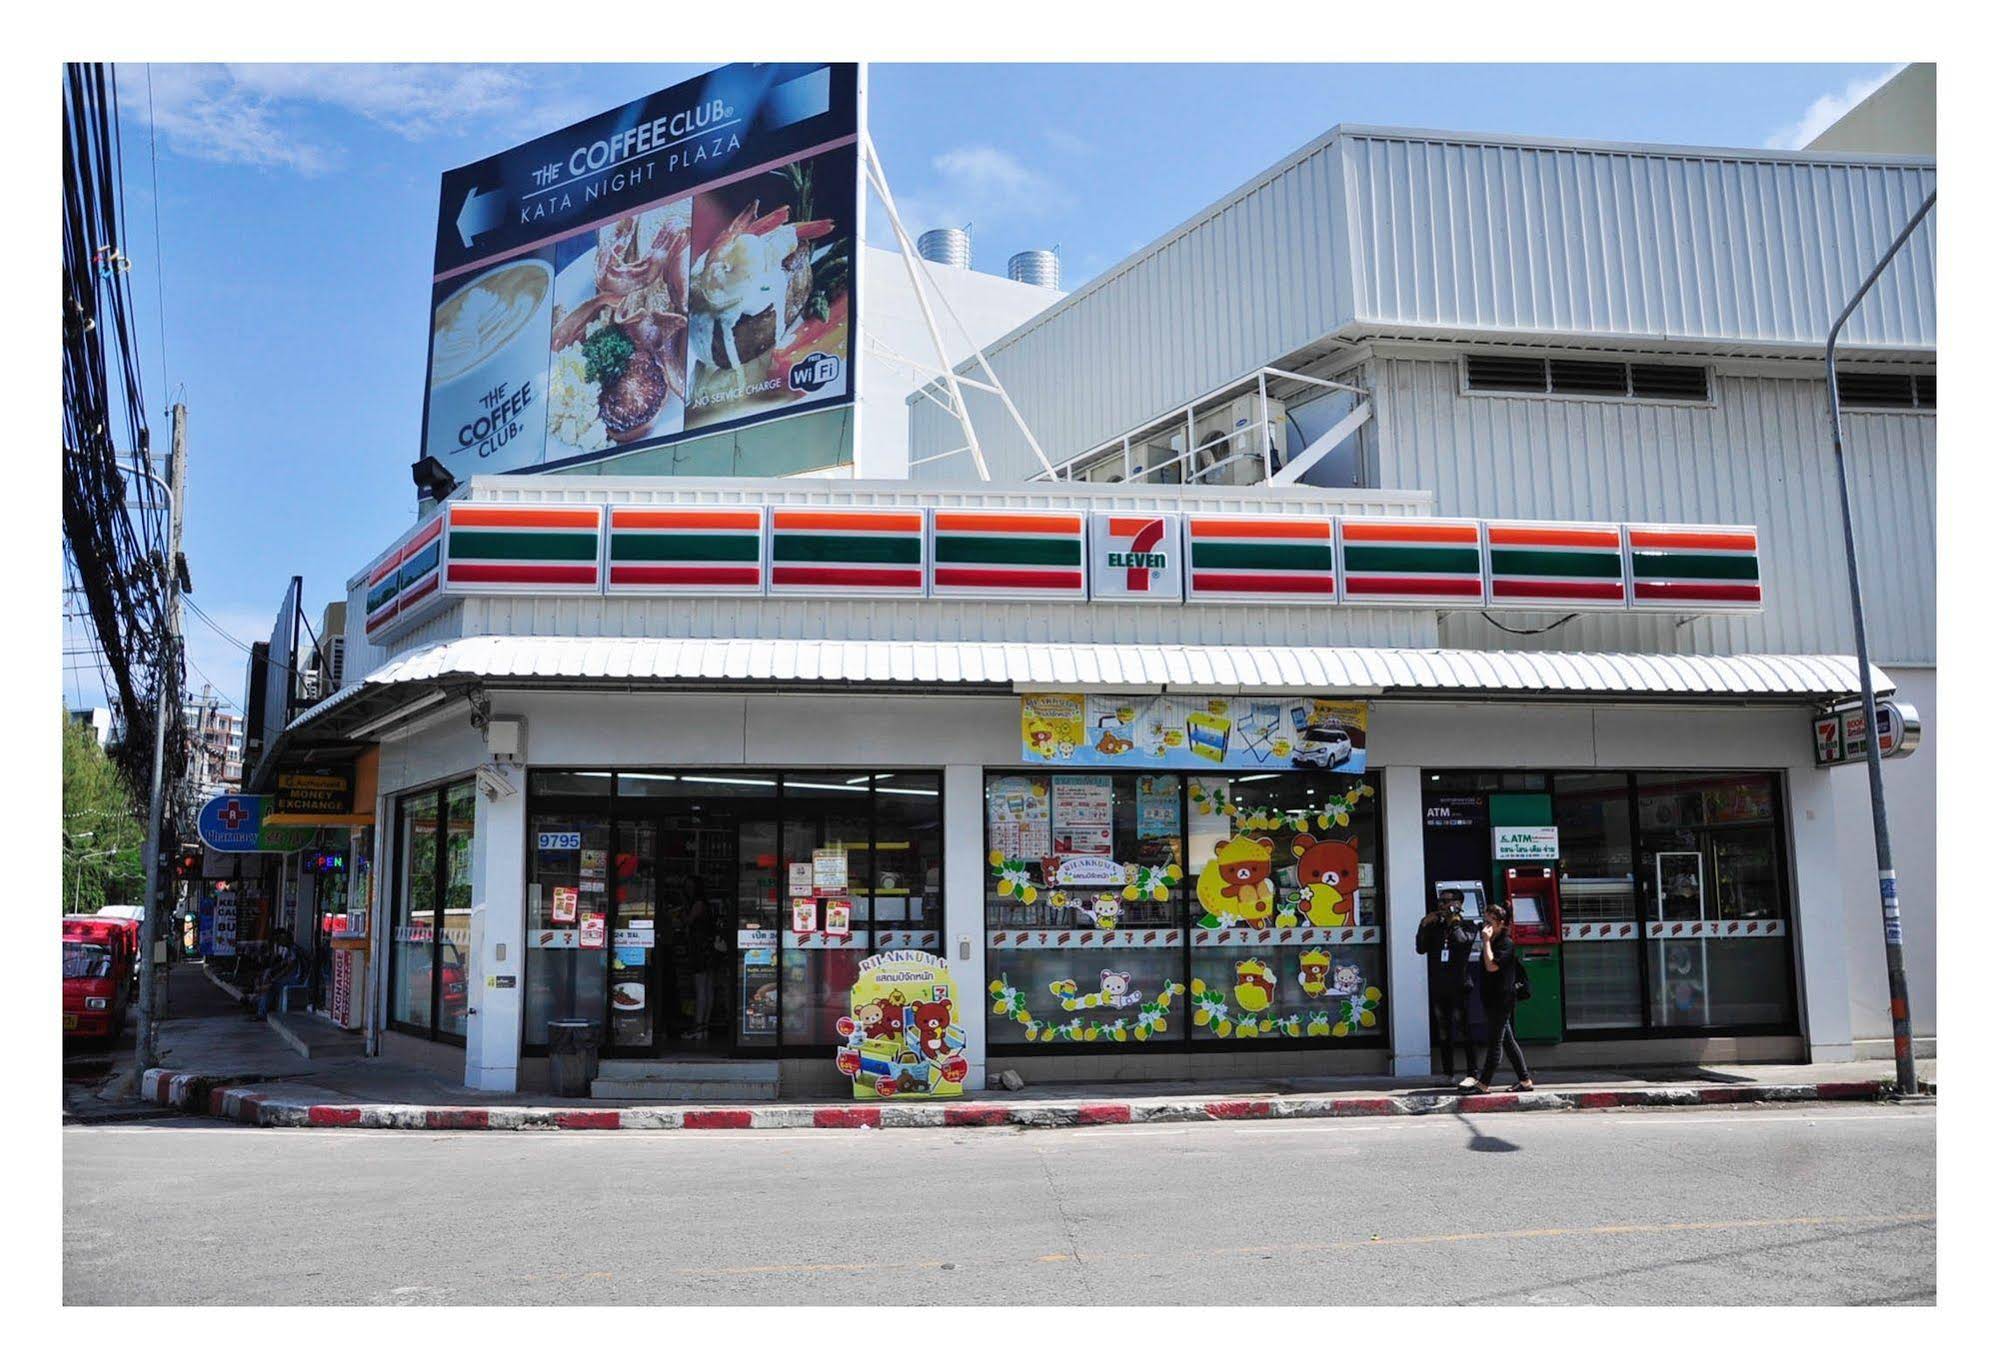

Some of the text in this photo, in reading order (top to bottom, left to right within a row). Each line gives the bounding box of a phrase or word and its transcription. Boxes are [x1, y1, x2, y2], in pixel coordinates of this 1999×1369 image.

[532, 162, 563, 187] THE
[569, 116, 668, 176] COFFEE
[521, 133, 741, 224] KATA NIGHT PLAZA
[479, 382, 508, 408] THE
[692, 378, 782, 409] NO SERVICE CHARGE
[458, 381, 531, 446] COFFEE
[479, 422, 518, 458] CLUB
[1108, 517, 1164, 591] 7
[290, 790, 333, 800] MONEY
[1427, 808, 1450, 817] ATM
[540, 834, 579, 848] 9795
[1511, 834, 1532, 842] ATM
[334, 951, 343, 1020] EXCHANGE
